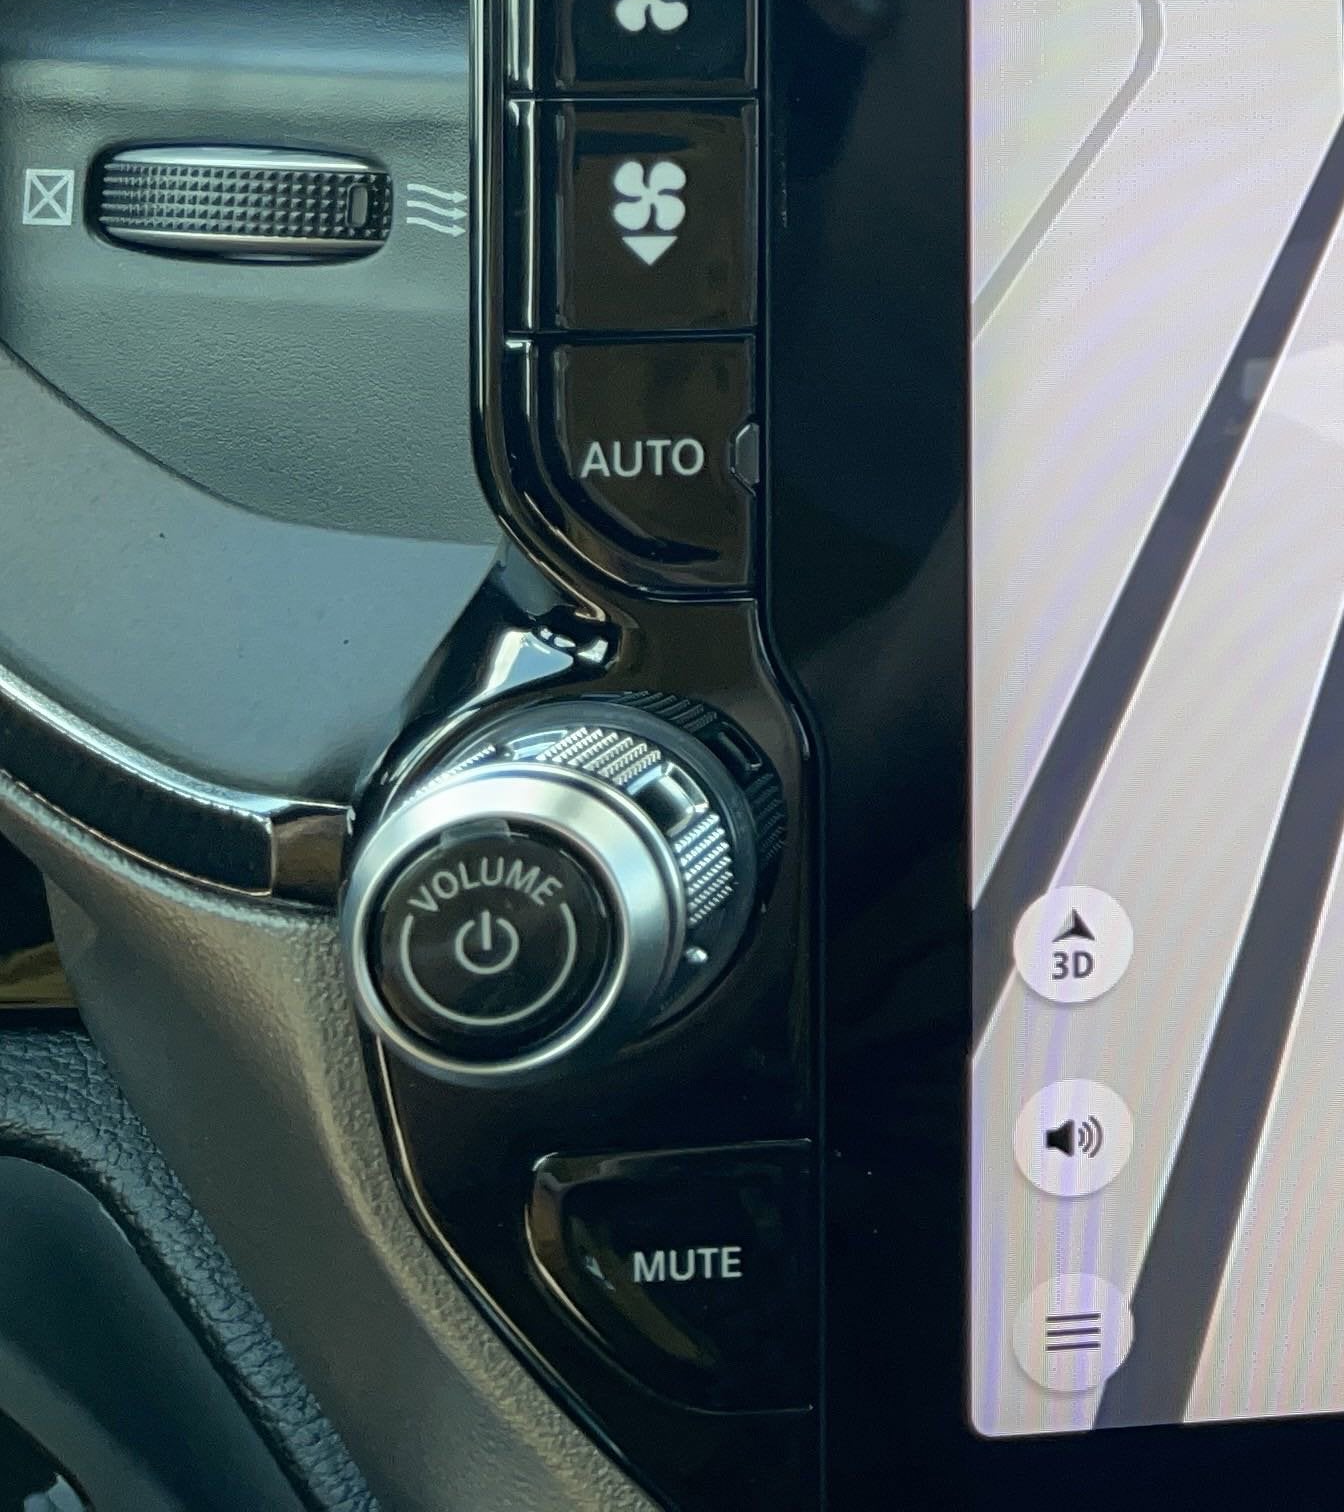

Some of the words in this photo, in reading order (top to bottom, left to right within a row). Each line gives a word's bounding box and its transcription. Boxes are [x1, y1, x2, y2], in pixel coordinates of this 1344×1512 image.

[580, 438, 705, 478] AUTO
[407, 857, 563, 913] VOLUME
[1052, 951, 1094, 980] 3D
[633, 1246, 743, 1283] MUTE
